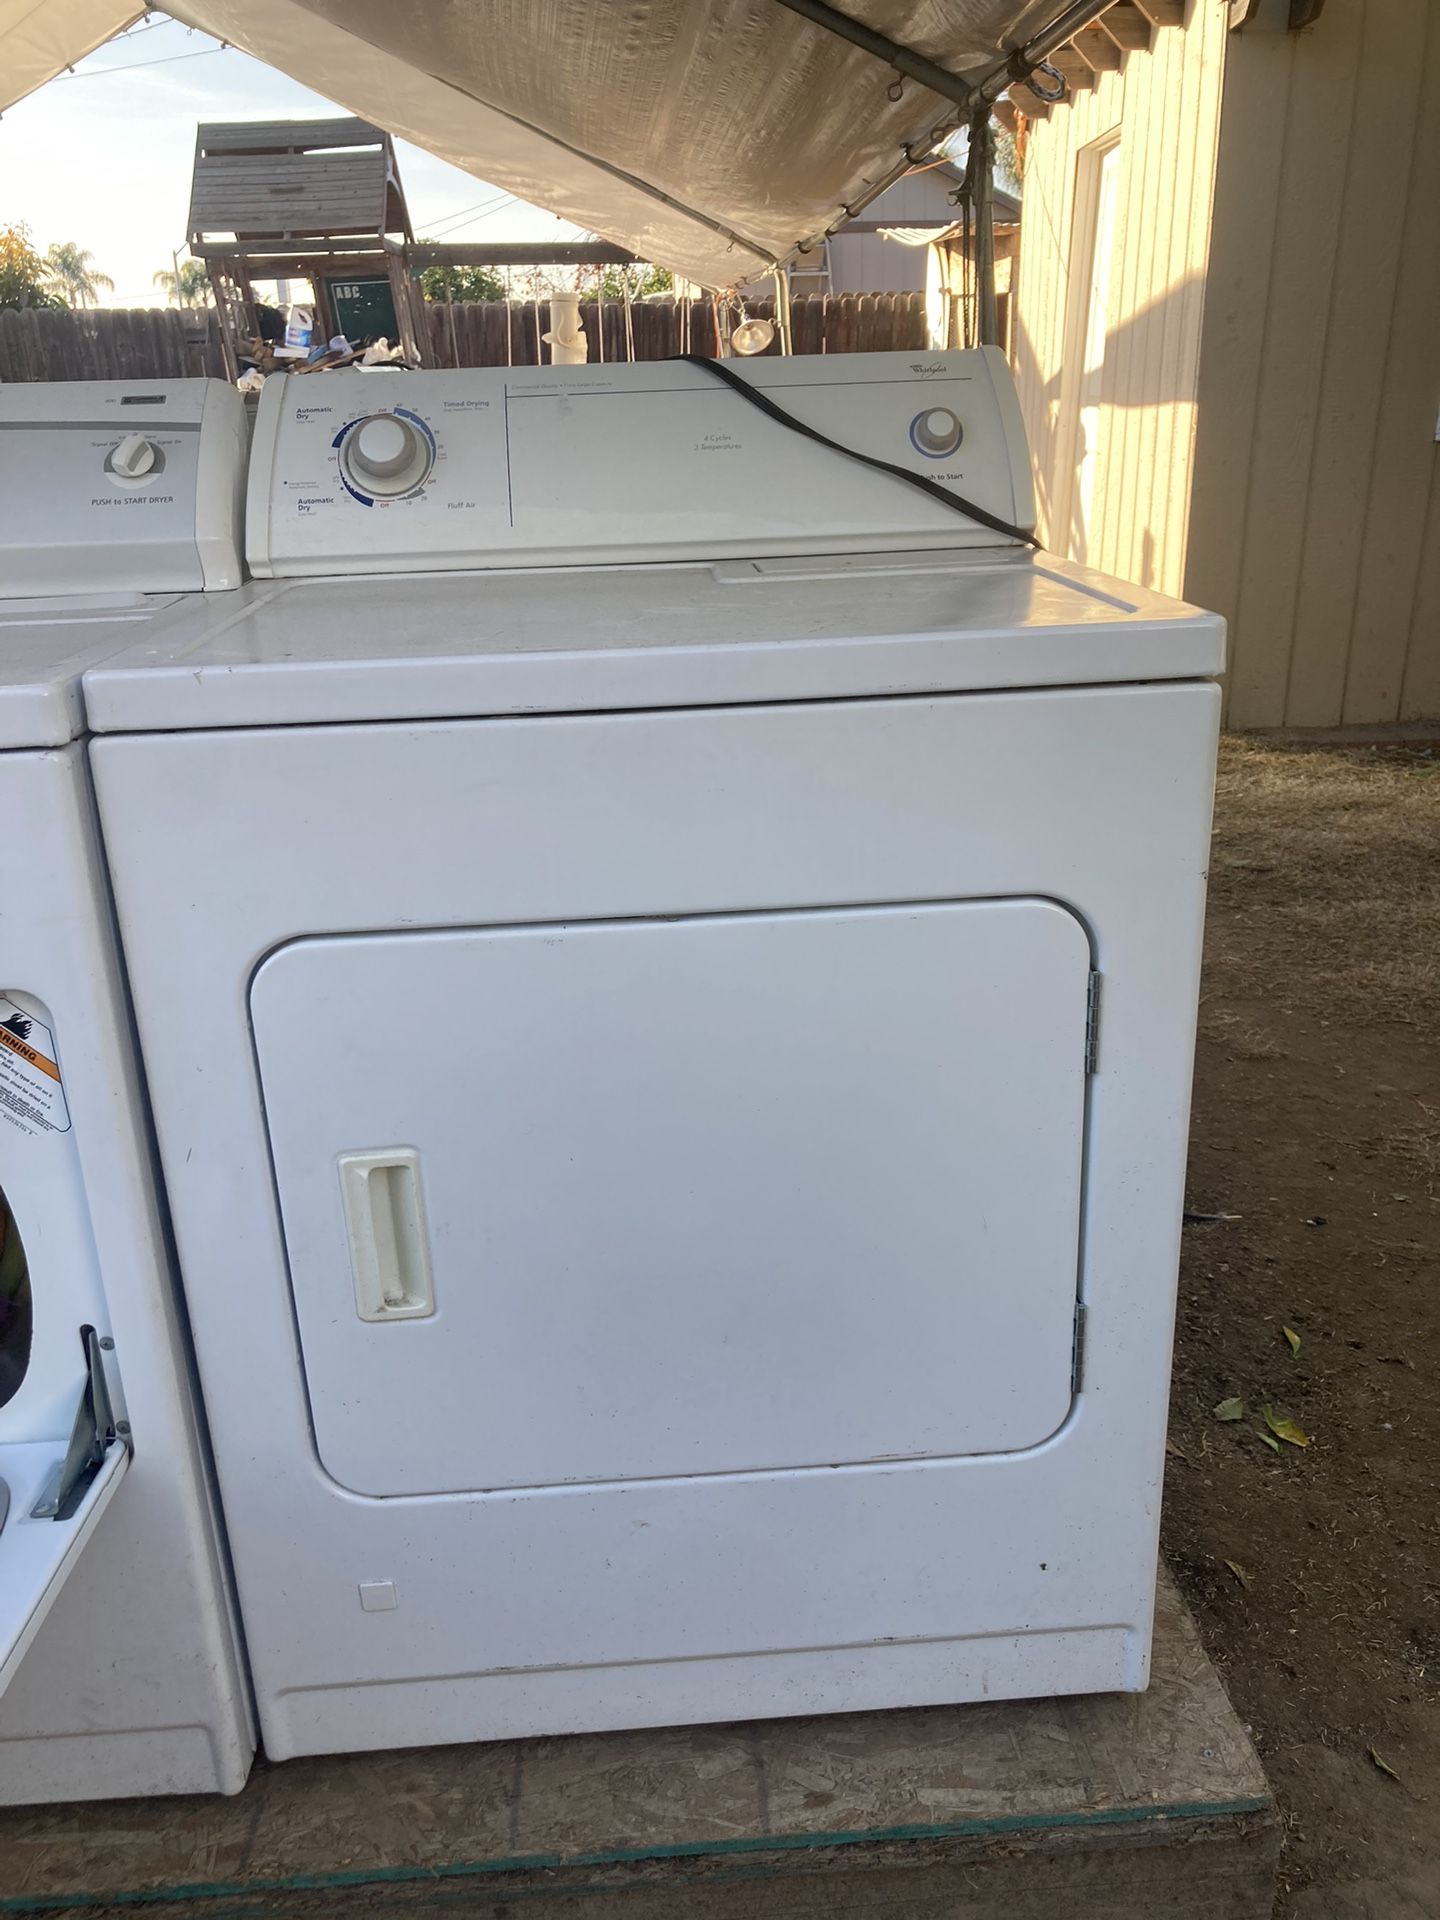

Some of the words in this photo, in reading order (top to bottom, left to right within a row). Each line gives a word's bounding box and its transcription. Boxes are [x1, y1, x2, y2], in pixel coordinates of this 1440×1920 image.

[336, 286, 360, 298] ABC
[91, 498, 111, 506] PUSH
[149, 496, 174, 504] DRYER
[0, 1030, 37, 1061] RNING
